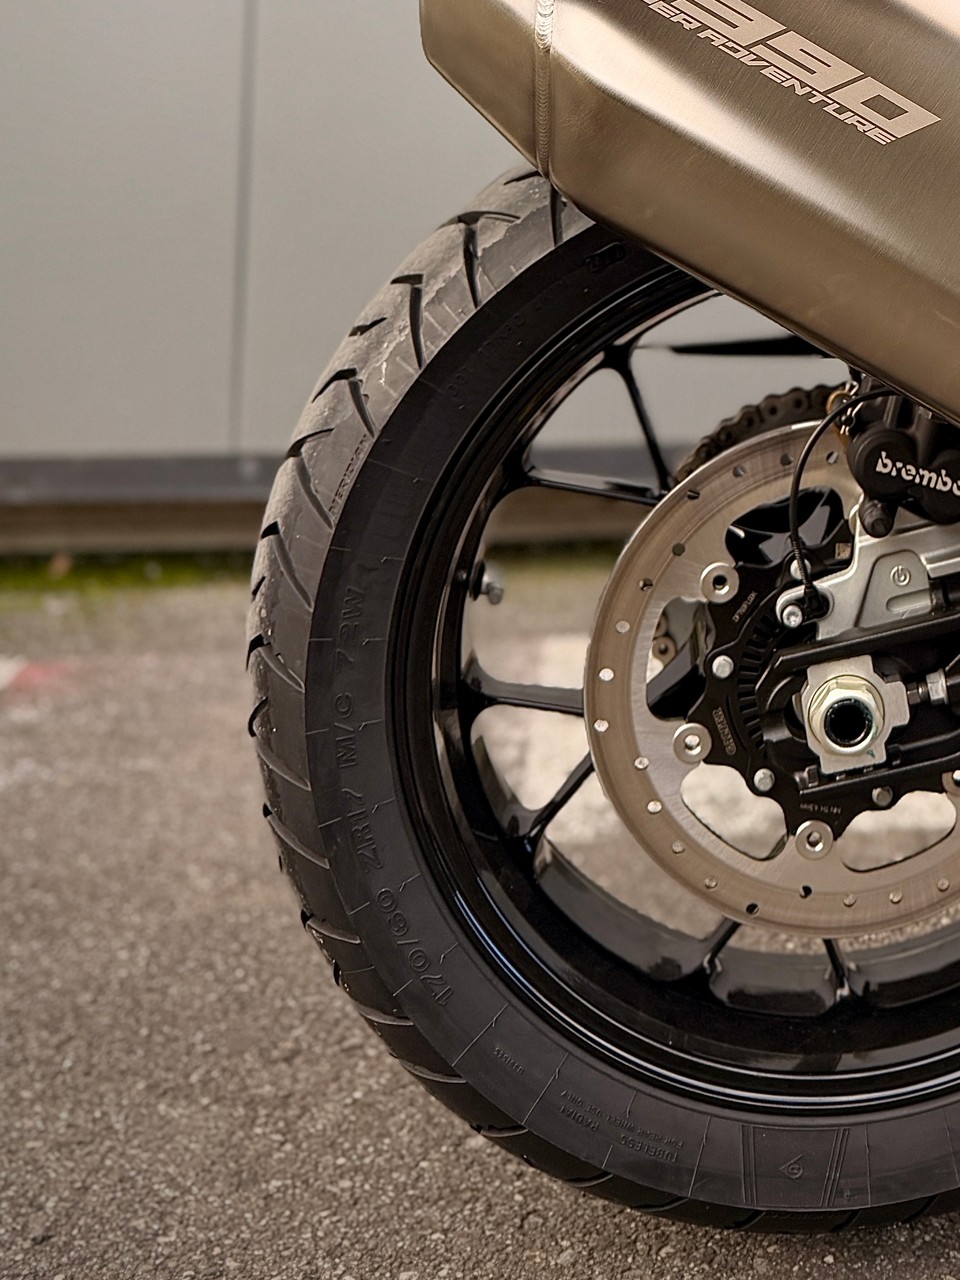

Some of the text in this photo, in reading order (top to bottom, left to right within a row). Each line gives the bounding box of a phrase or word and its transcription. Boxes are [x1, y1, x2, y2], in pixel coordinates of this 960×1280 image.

[696, 28, 897, 146] ADVENTURE
[333, 691, 358, 768] M/C
[376, 887, 455, 1006] 170/60
[559, 1105, 679, 1163] TUBELESS RADIAL
[606, 1113, 635, 1133] WHEEL
